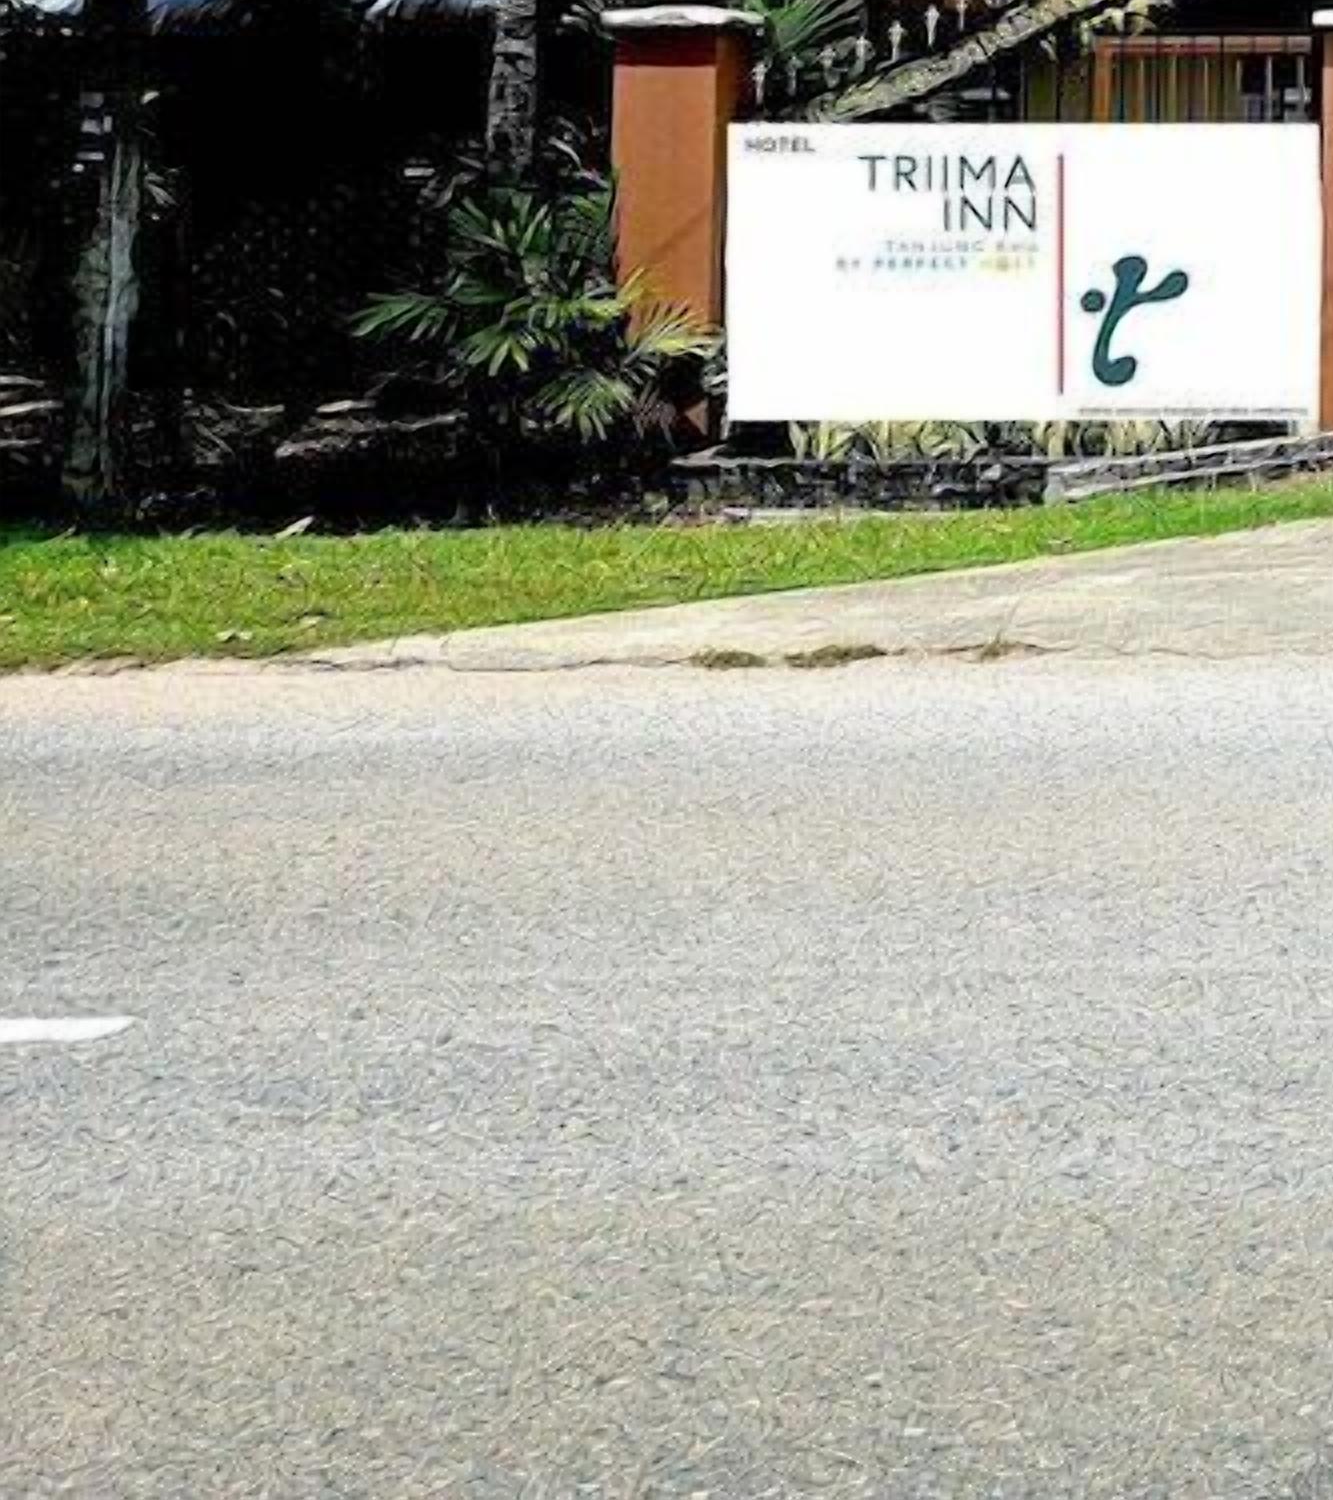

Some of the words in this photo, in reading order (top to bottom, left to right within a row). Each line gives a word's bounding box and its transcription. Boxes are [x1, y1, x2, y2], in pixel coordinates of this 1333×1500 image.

[744, 136, 815, 153] HOTEL
[857, 153, 1036, 191] TRIIMA
[943, 196, 1036, 232] INN
